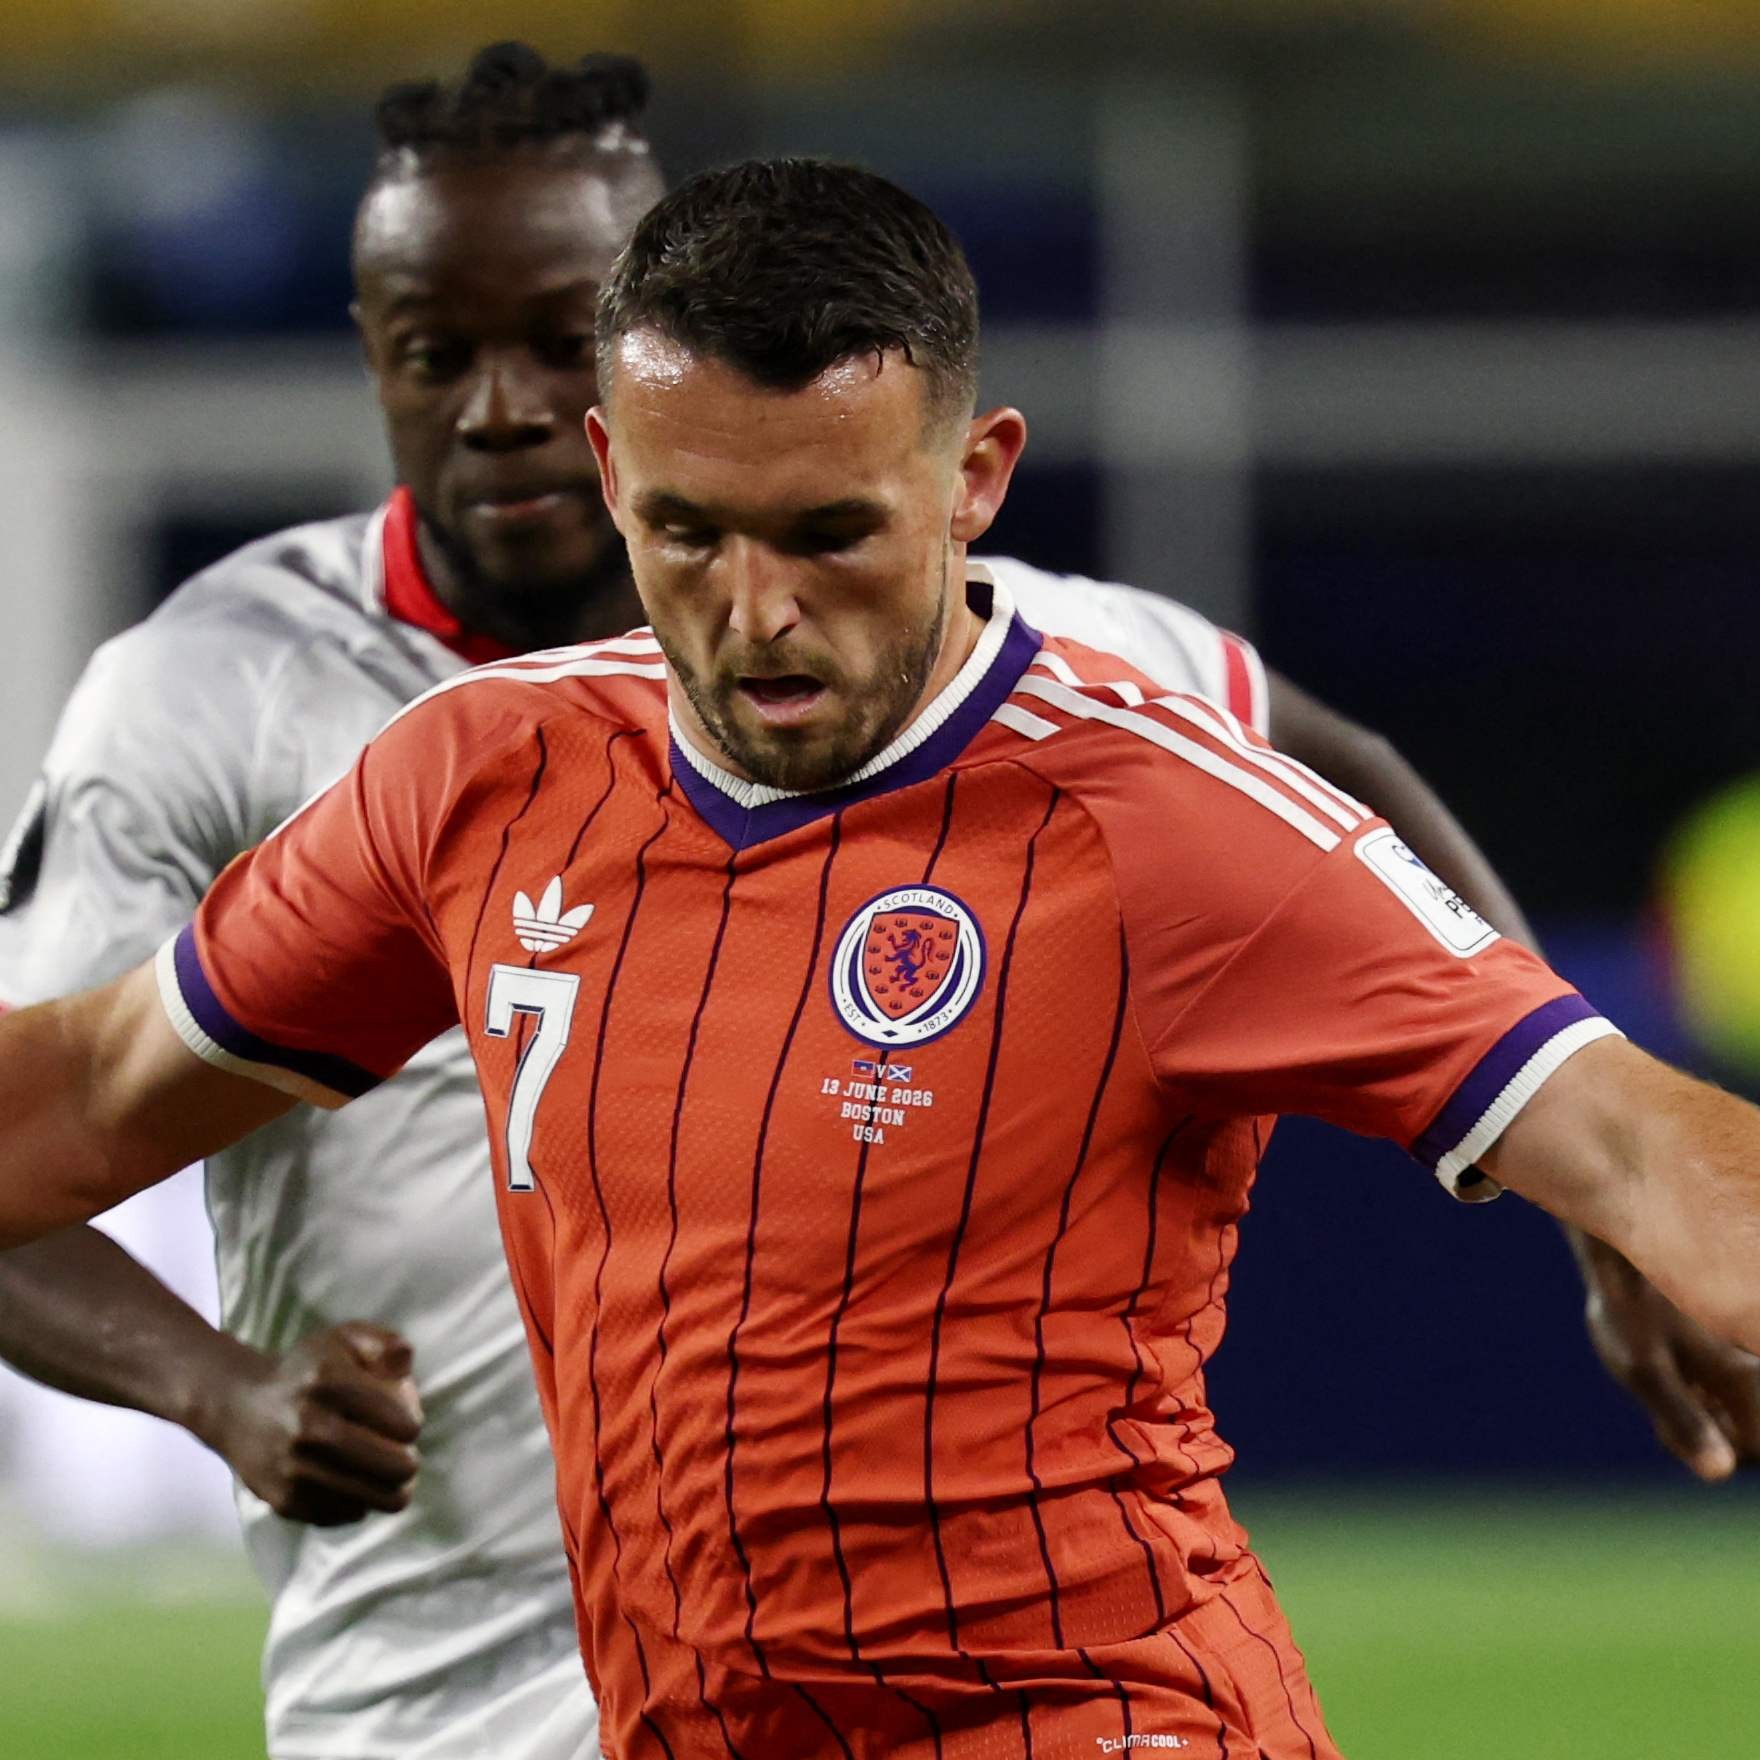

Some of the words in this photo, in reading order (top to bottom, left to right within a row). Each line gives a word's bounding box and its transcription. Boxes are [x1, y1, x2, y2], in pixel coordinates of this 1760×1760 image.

[883, 892, 954, 914] SCOTLAND
[843, 1003, 861, 1022] EST
[923, 1011, 949, 1032] 1873
[484, 964, 581, 1192] 7
[821, 1078, 840, 1095] 13
[843, 1081, 887, 1103] JUNE
[891, 1088, 933, 1107] 2026
[840, 1101, 905, 1126] BOSTON
[852, 1124, 885, 1145] USA
